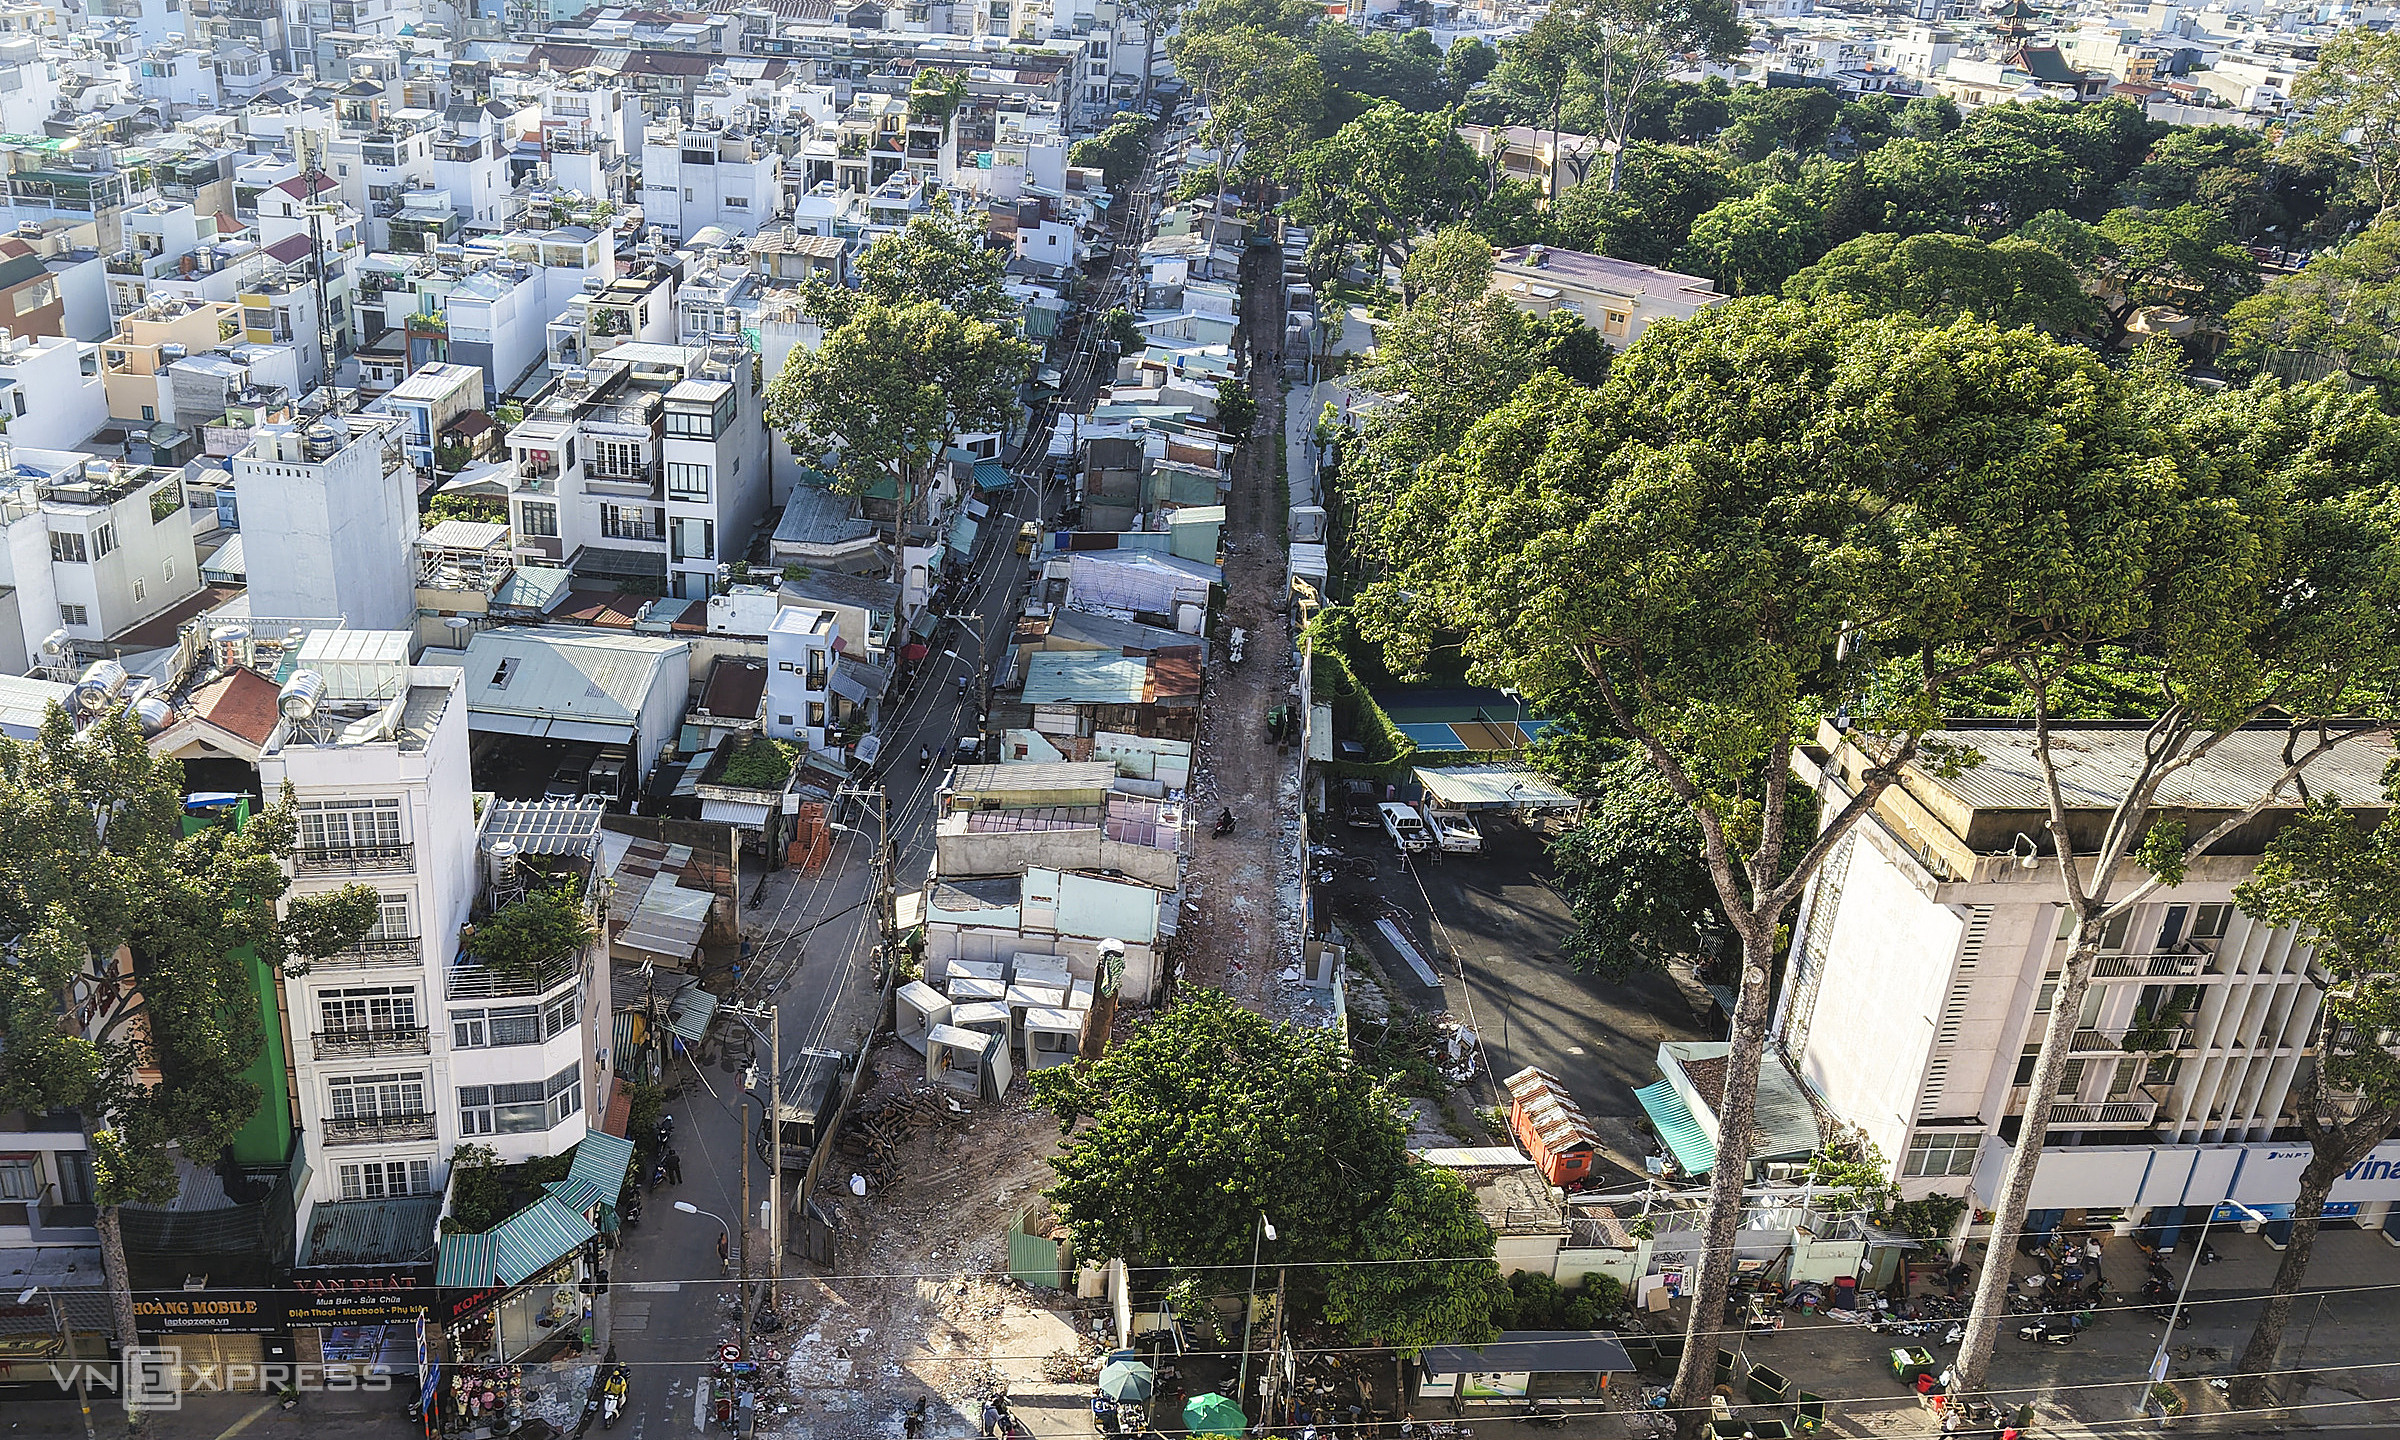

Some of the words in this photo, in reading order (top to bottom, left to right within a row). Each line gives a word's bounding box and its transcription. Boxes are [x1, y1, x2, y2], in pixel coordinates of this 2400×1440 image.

[293, 1279, 346, 1296] VẠN
[349, 1273, 417, 1293] PHÁT
[316, 1298, 334, 1306] Mua
[335, 1297, 352, 1305] Bán
[192, 1301, 258, 1314] MOBILE
[342, 1307, 385, 1316] Macbook
[164, 1317, 230, 1327] laptopzone.vn
